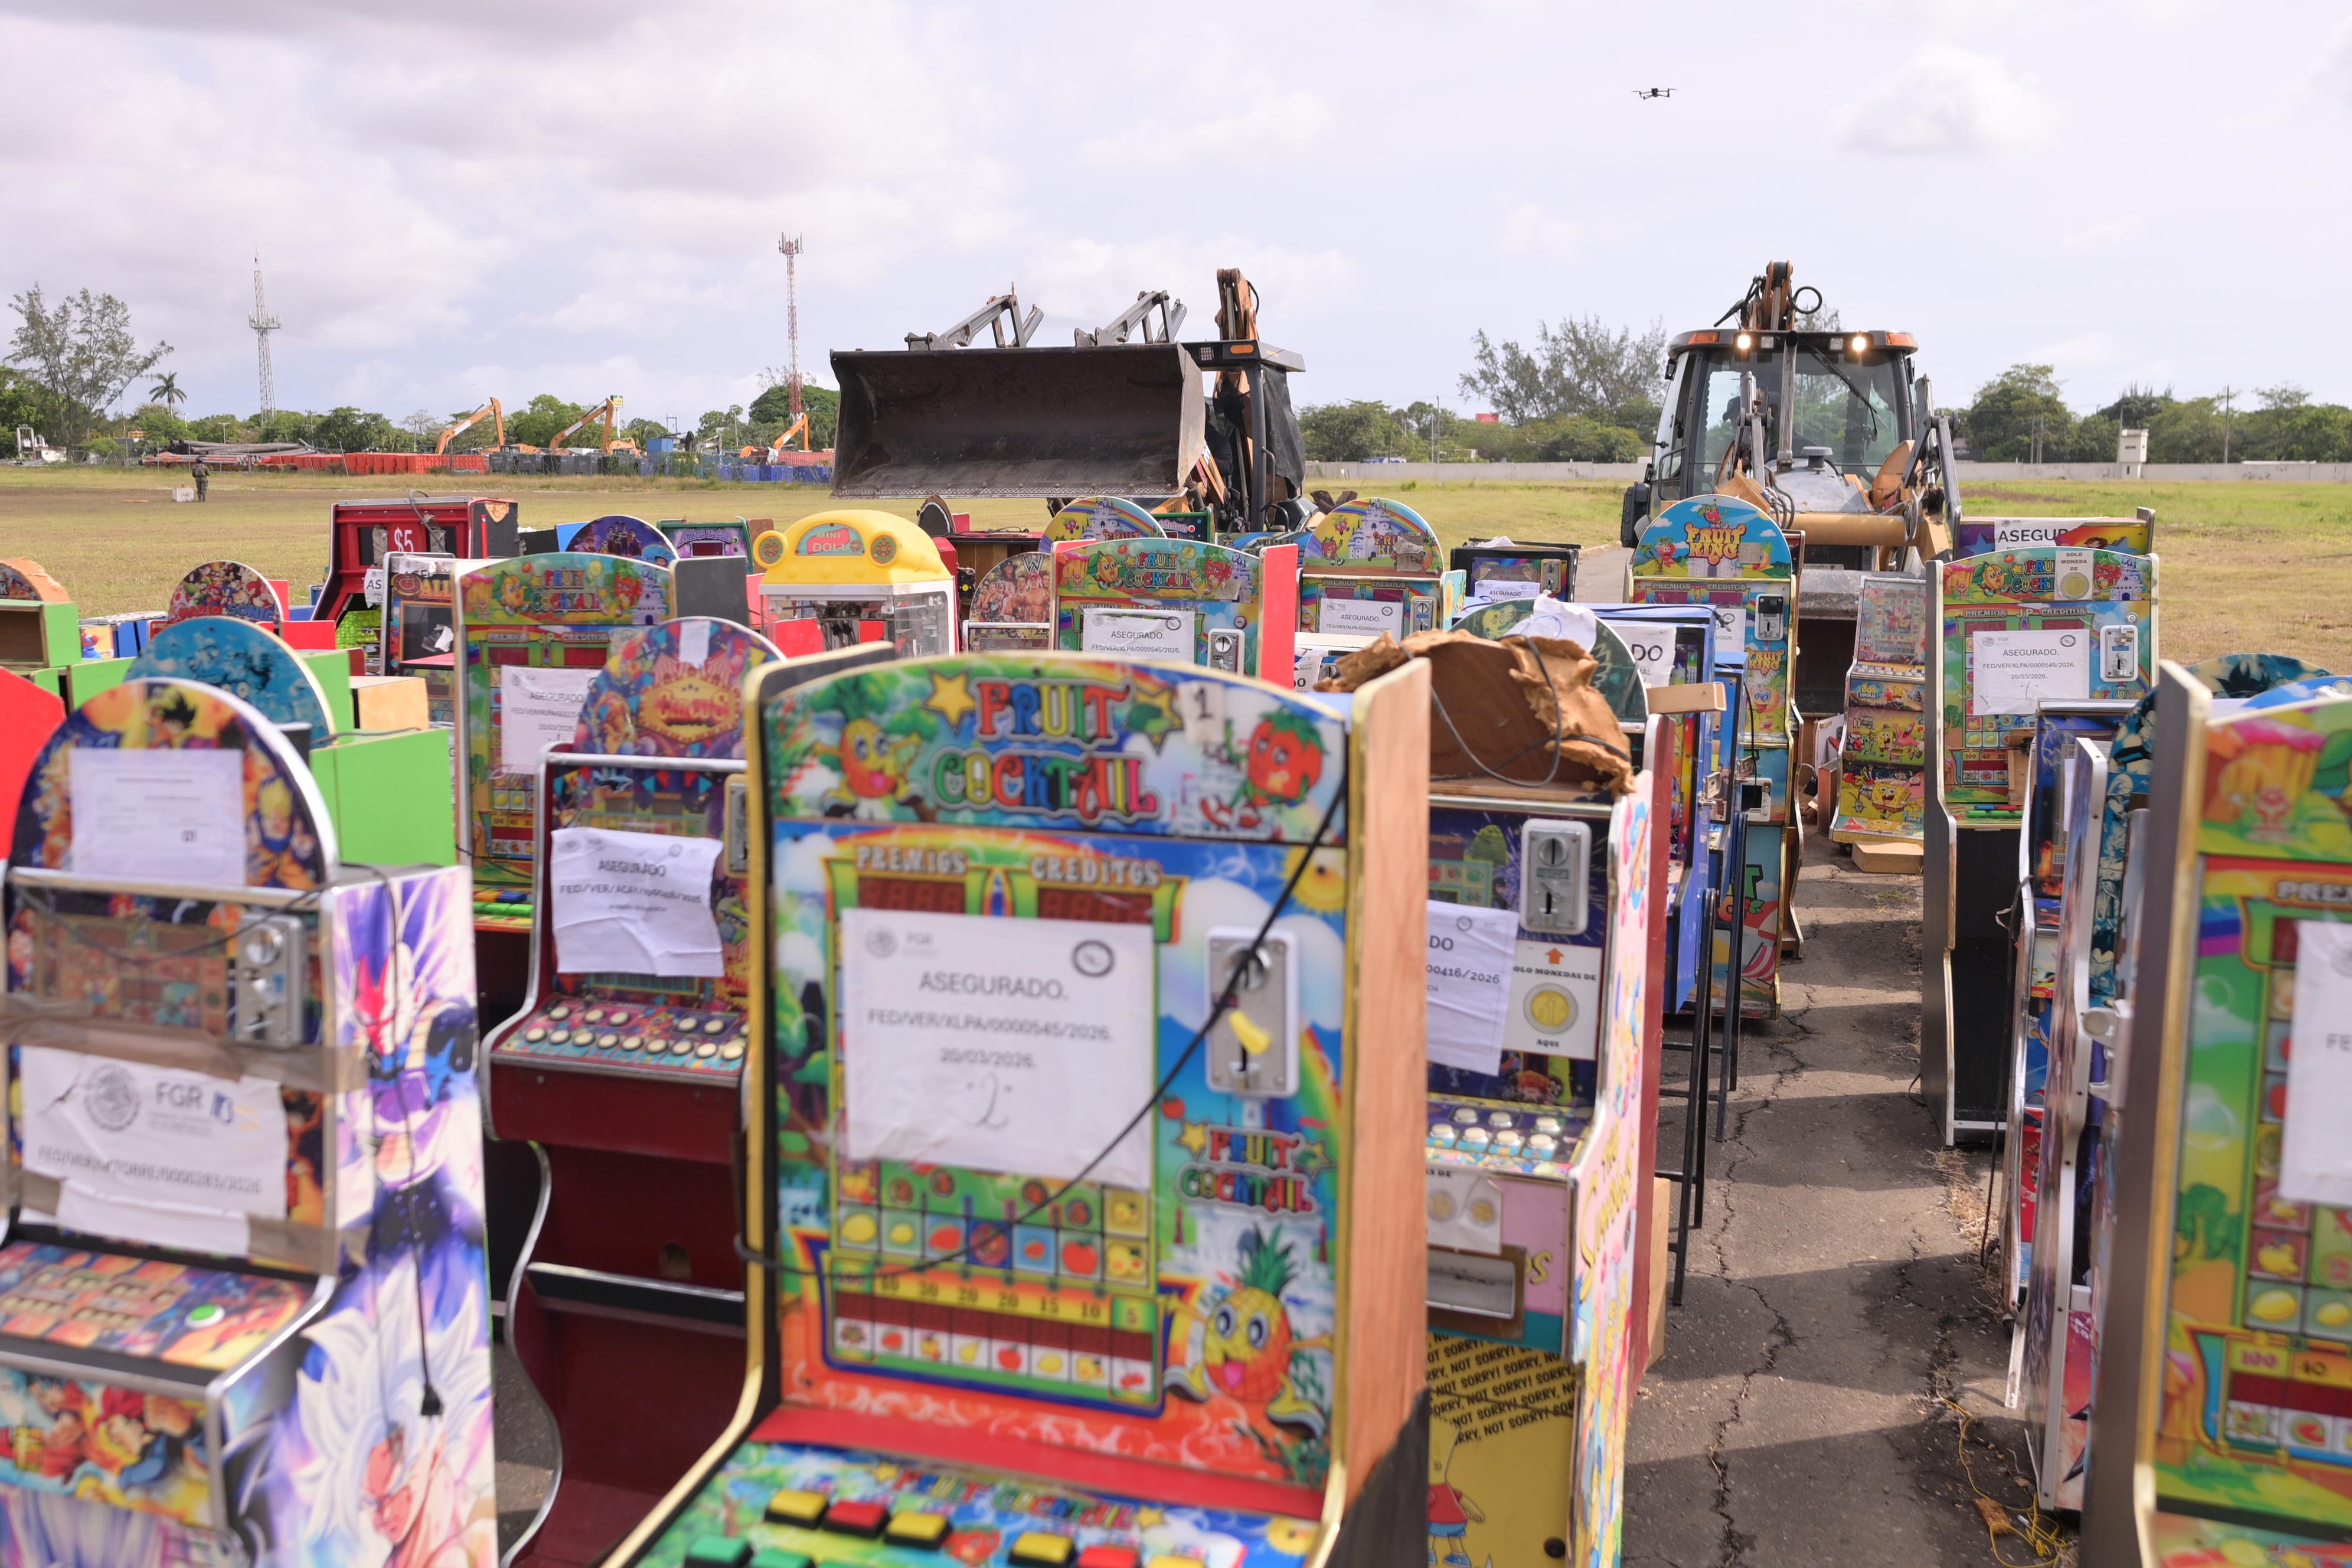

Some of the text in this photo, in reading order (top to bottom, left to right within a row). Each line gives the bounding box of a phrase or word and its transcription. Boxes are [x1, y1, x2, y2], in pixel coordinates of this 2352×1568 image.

[1376, 534, 1397, 545] FRU
[1685, 523, 1746, 543] FRUIT
[812, 543, 848, 552] DOLL
[1689, 542, 1739, 564] KING
[1138, 552, 1178, 567] FRUIT
[2026, 560, 2055, 573] FRU
[544, 570, 586, 587] FRUIT
[1125, 570, 1191, 587] COCKTAIL
[533, 593, 600, 610] COCKTAIL
[228, 603, 275, 621] SONIC
[1341, 614, 1380, 622] ASEGURADO.
[1111, 631, 1165, 639] ASEGURADO.
[977, 681, 1131, 739] FRUIT
[934, 753, 1157, 818] COCKTAIL
[598, 860, 667, 877] ASEGURADO
[1534, 967, 1581, 979] MONEDAS
[1584, 973, 1596, 981] DE
[919, 971, 1069, 1001] ASEGURADO.
[1536, 1038, 1560, 1048] AQUI
[155, 1082, 204, 1109] FGR
[1210, 1130, 1300, 1171] FRUIT
[1182, 1168, 1312, 1213] COCKTAIL
[917, 1282, 939, 1298] 30
[956, 1287, 979, 1304] 20
[997, 1292, 1020, 1309] 20
[1039, 1296, 1060, 1314] 15
[1080, 1302, 1101, 1319] 10
[1451, 1358, 1471, 1373] NOT
[1475, 1345, 1515, 1366] SORRY!
[1436, 1381, 1456, 1397] NOT
[1461, 1367, 1500, 1388] SORRY!
[1504, 1355, 1543, 1375] SORRY,
[1467, 1391, 1488, 1405] NOT
[1492, 1376, 1533, 1396] SORRY!
[1536, 1365, 1574, 1384] SORRY,
[1453, 1413, 1473, 1427] NOT
[1477, 1398, 1517, 1420] SORRY!
[1521, 1387, 1560, 1406] SORRY,
[1484, 1422, 1505, 1436] NOT
[1509, 1407, 1549, 1429] SORRY!
